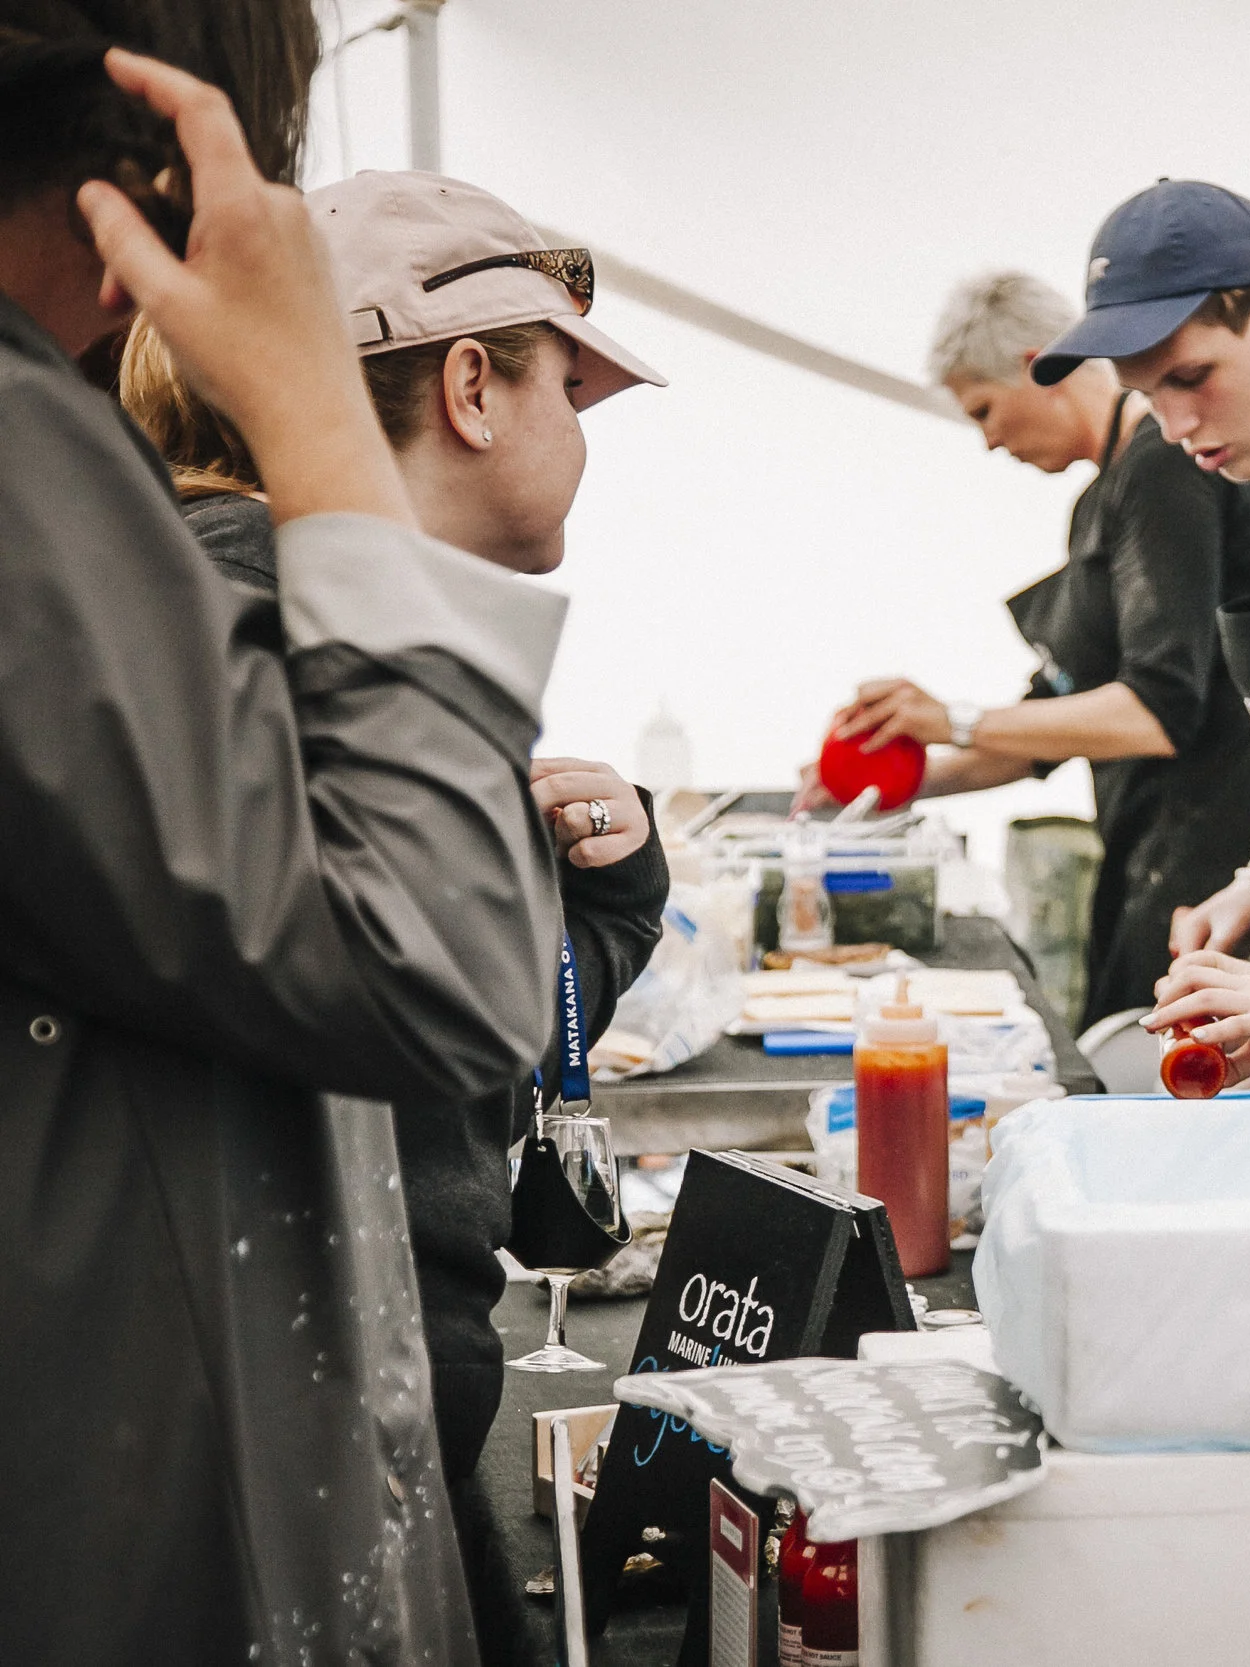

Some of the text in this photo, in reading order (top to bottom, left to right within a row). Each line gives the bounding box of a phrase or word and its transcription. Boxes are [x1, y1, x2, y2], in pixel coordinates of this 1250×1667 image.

[564, 968, 581, 1067] MATAKANA
[667, 1330, 712, 1368] MARINE
[679, 1273, 774, 1358] orata
